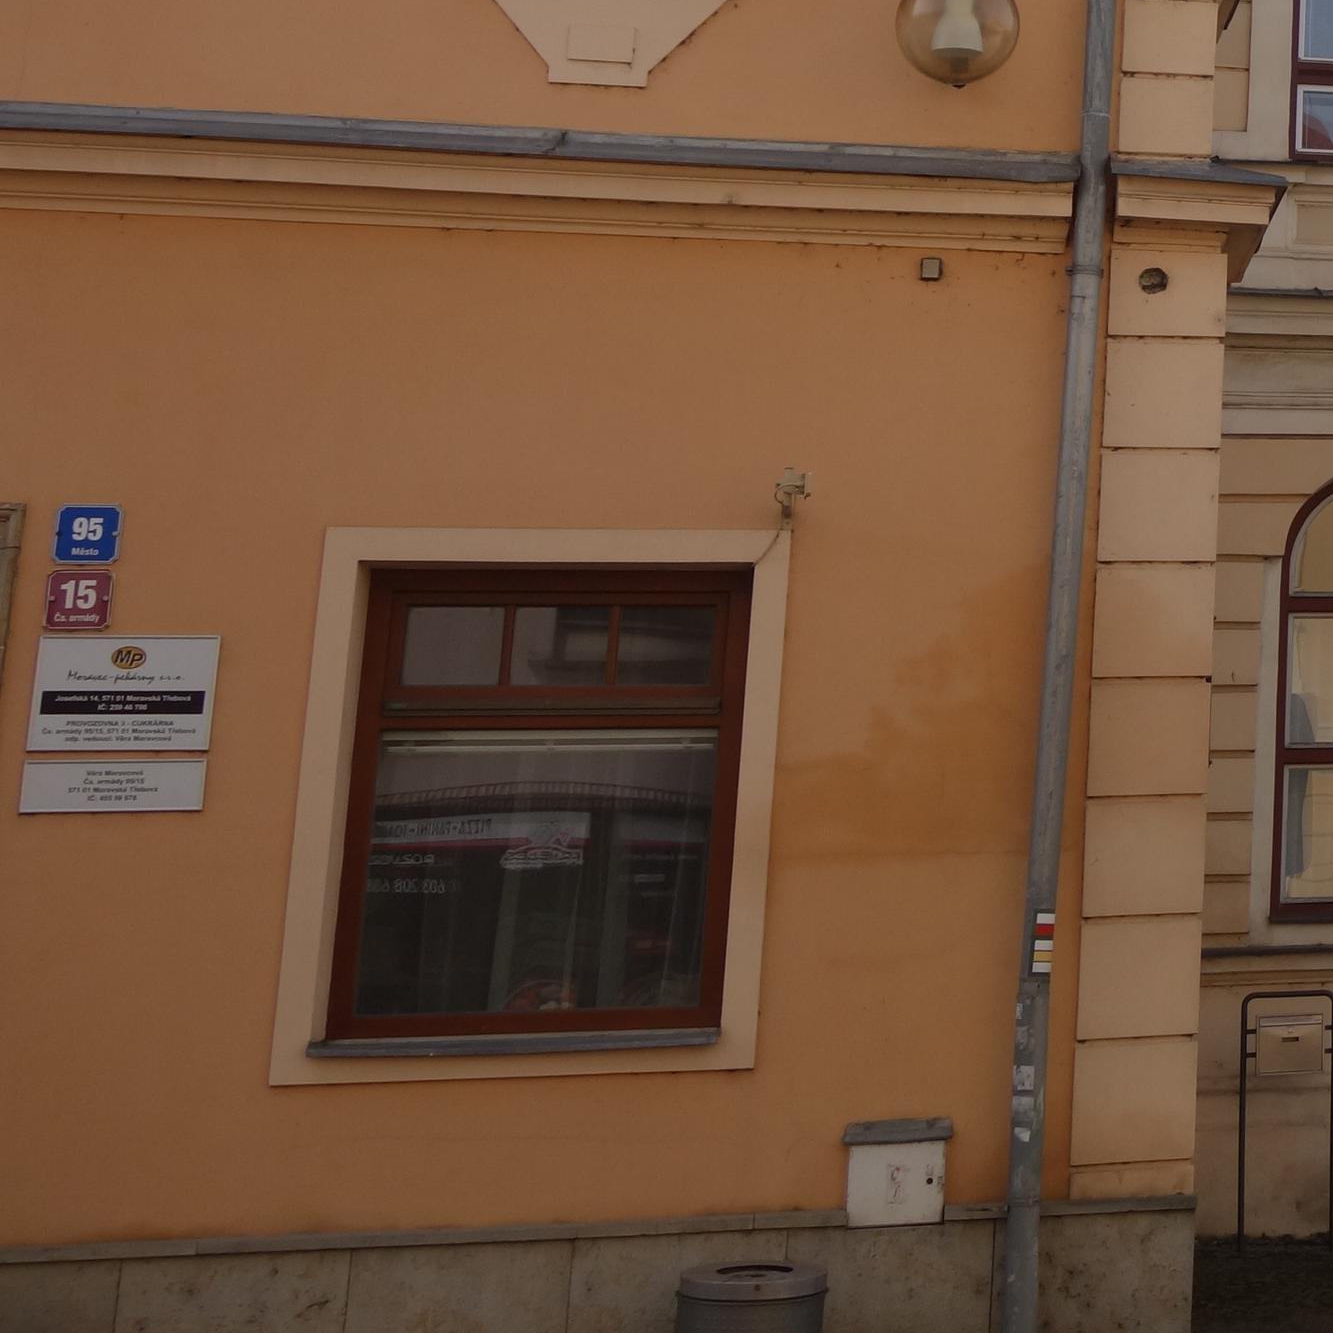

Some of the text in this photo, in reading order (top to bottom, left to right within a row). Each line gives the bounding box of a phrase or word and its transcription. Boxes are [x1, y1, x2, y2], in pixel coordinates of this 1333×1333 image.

[71, 517, 104, 542] 95
[60, 579, 97, 609] 15
[115, 649, 144, 666] MP
